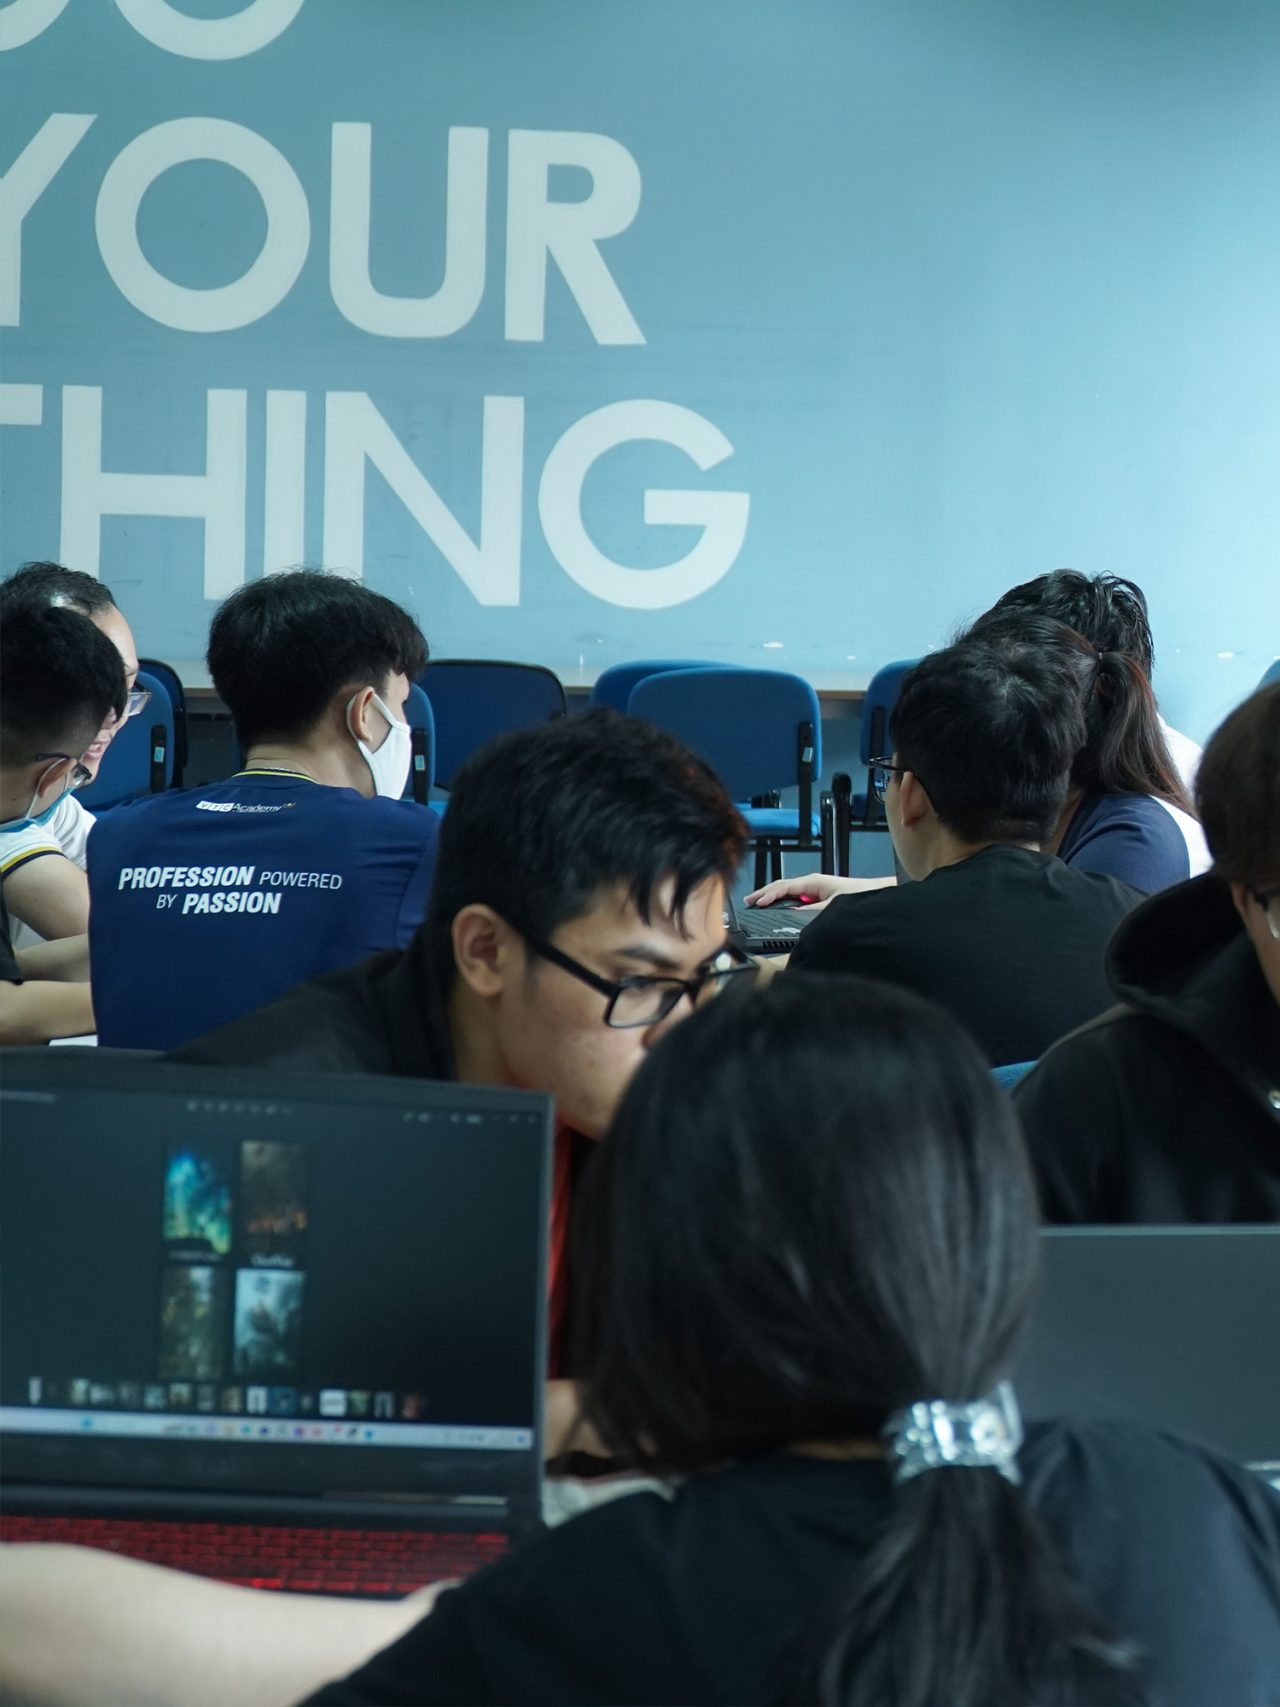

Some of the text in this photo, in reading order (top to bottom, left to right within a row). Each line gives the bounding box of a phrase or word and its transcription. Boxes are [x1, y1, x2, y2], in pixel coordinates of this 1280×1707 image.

[0, 383, 751, 610] HING
[233, 803, 282, 812] Academy
[118, 866, 343, 890] PROFESSION POWERED
[156, 891, 282, 915] BY PASSION
